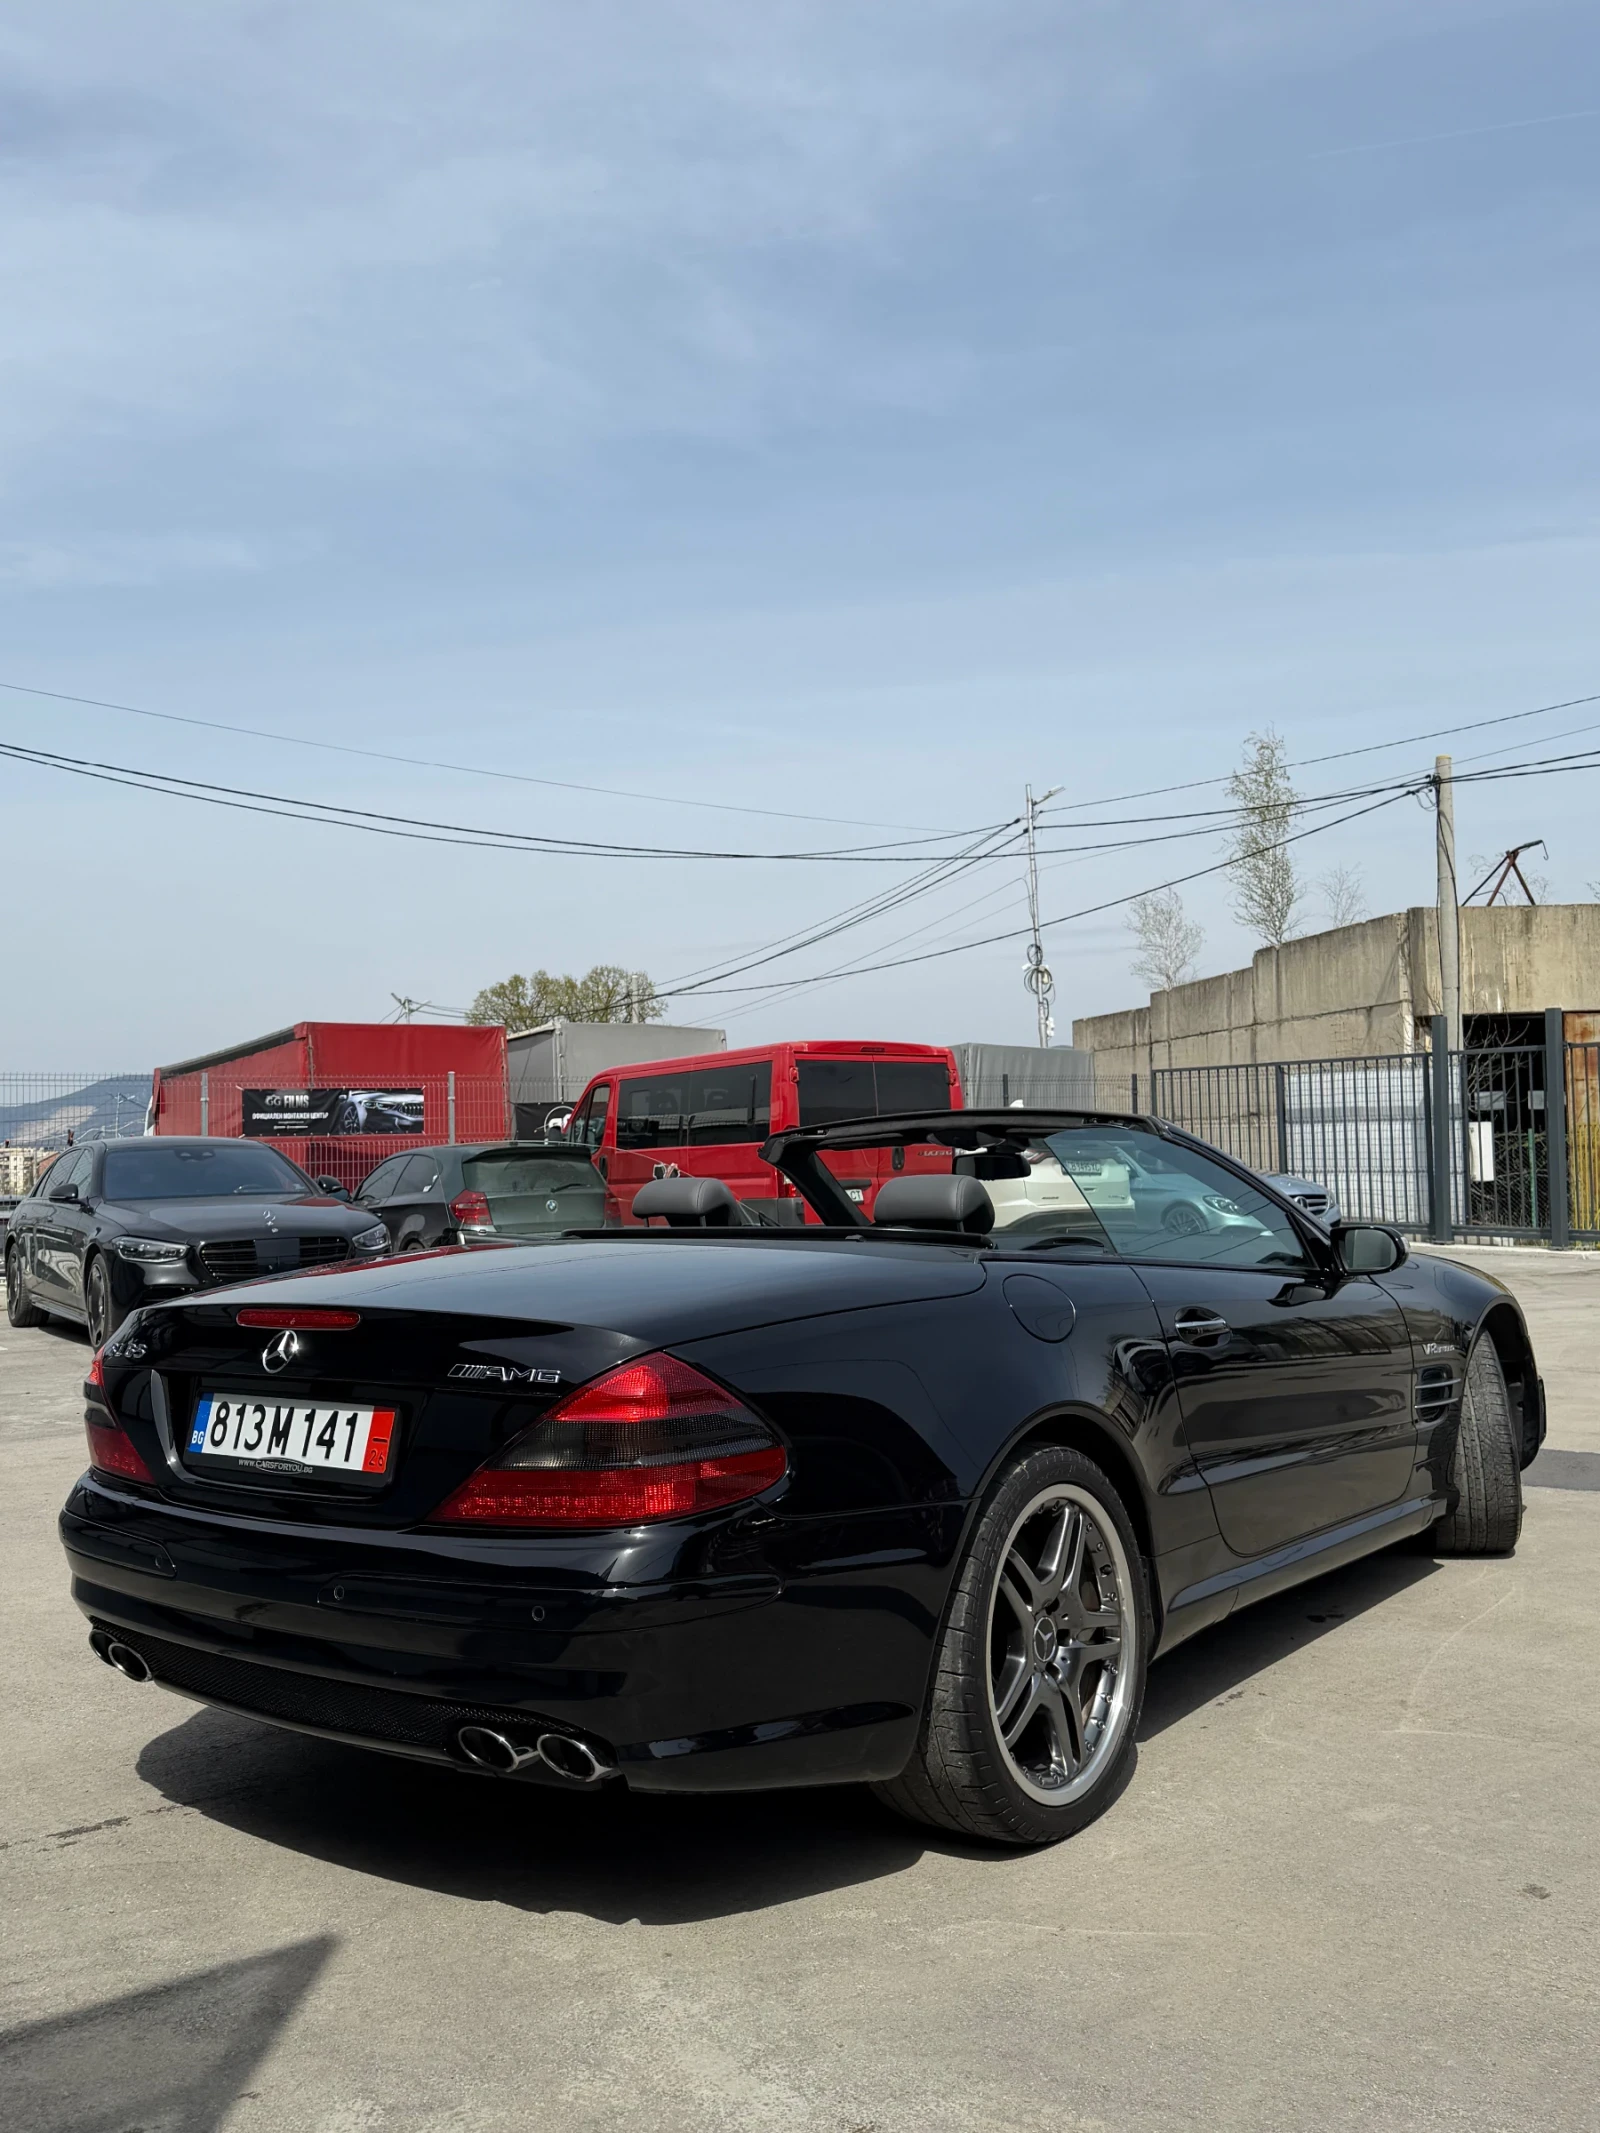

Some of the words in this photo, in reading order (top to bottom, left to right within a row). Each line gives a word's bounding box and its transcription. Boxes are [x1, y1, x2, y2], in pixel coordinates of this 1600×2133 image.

[284, 1095, 309, 1108] FILMS
[484, 1365, 561, 1384] AMG
[191, 1430, 205, 1445] BG
[368, 1450, 386, 1468] 26
